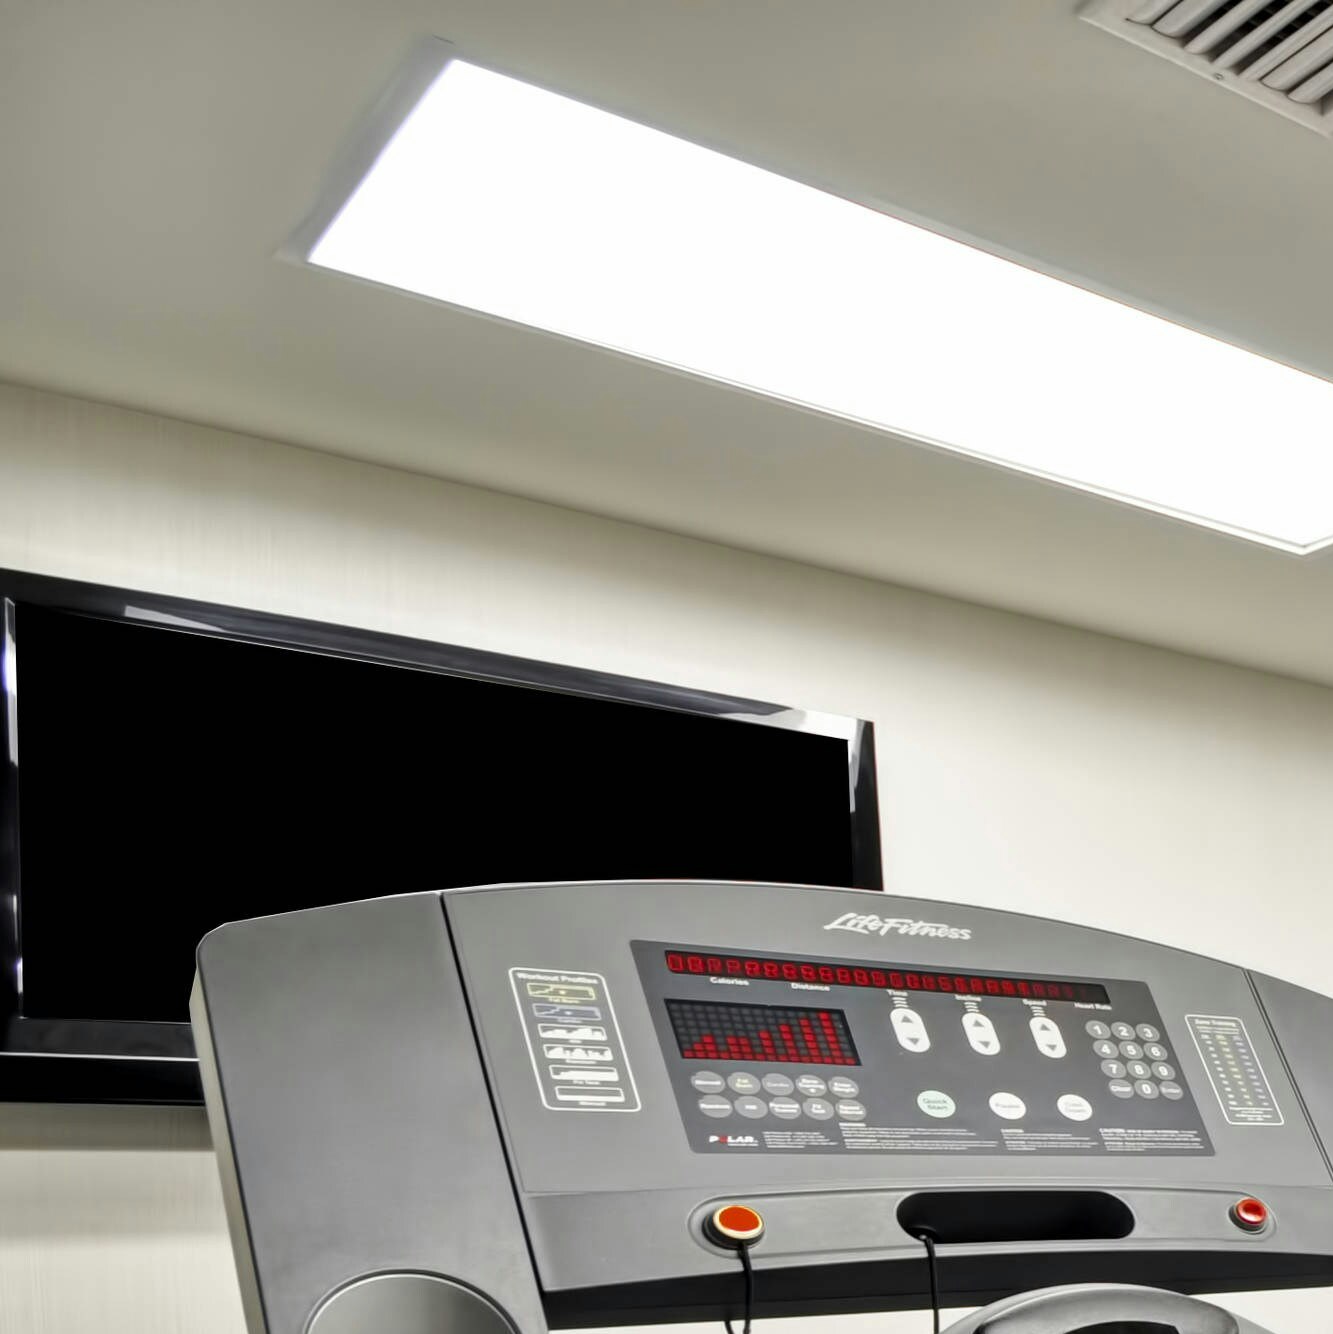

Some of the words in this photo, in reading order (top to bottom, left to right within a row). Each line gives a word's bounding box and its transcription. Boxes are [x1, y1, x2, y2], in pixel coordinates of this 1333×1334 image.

[710, 976, 749, 986] Calories
[791, 982, 830, 992] Distance
[1093, 1025, 1102, 1035] 1
[1118, 1026, 1129, 1037] 2
[1143, 1027, 1153, 1038] 3
[1101, 1044, 1111, 1054] 4
[1126, 1045, 1137, 1056] 5
[1151, 1046, 1161, 1057] 6
[1108, 1063, 1118, 1074] 7
[1134, 1064, 1144, 1075] 8
[1158, 1065, 1168, 1076] 9
[1141, 1083, 1152, 1094] 0
